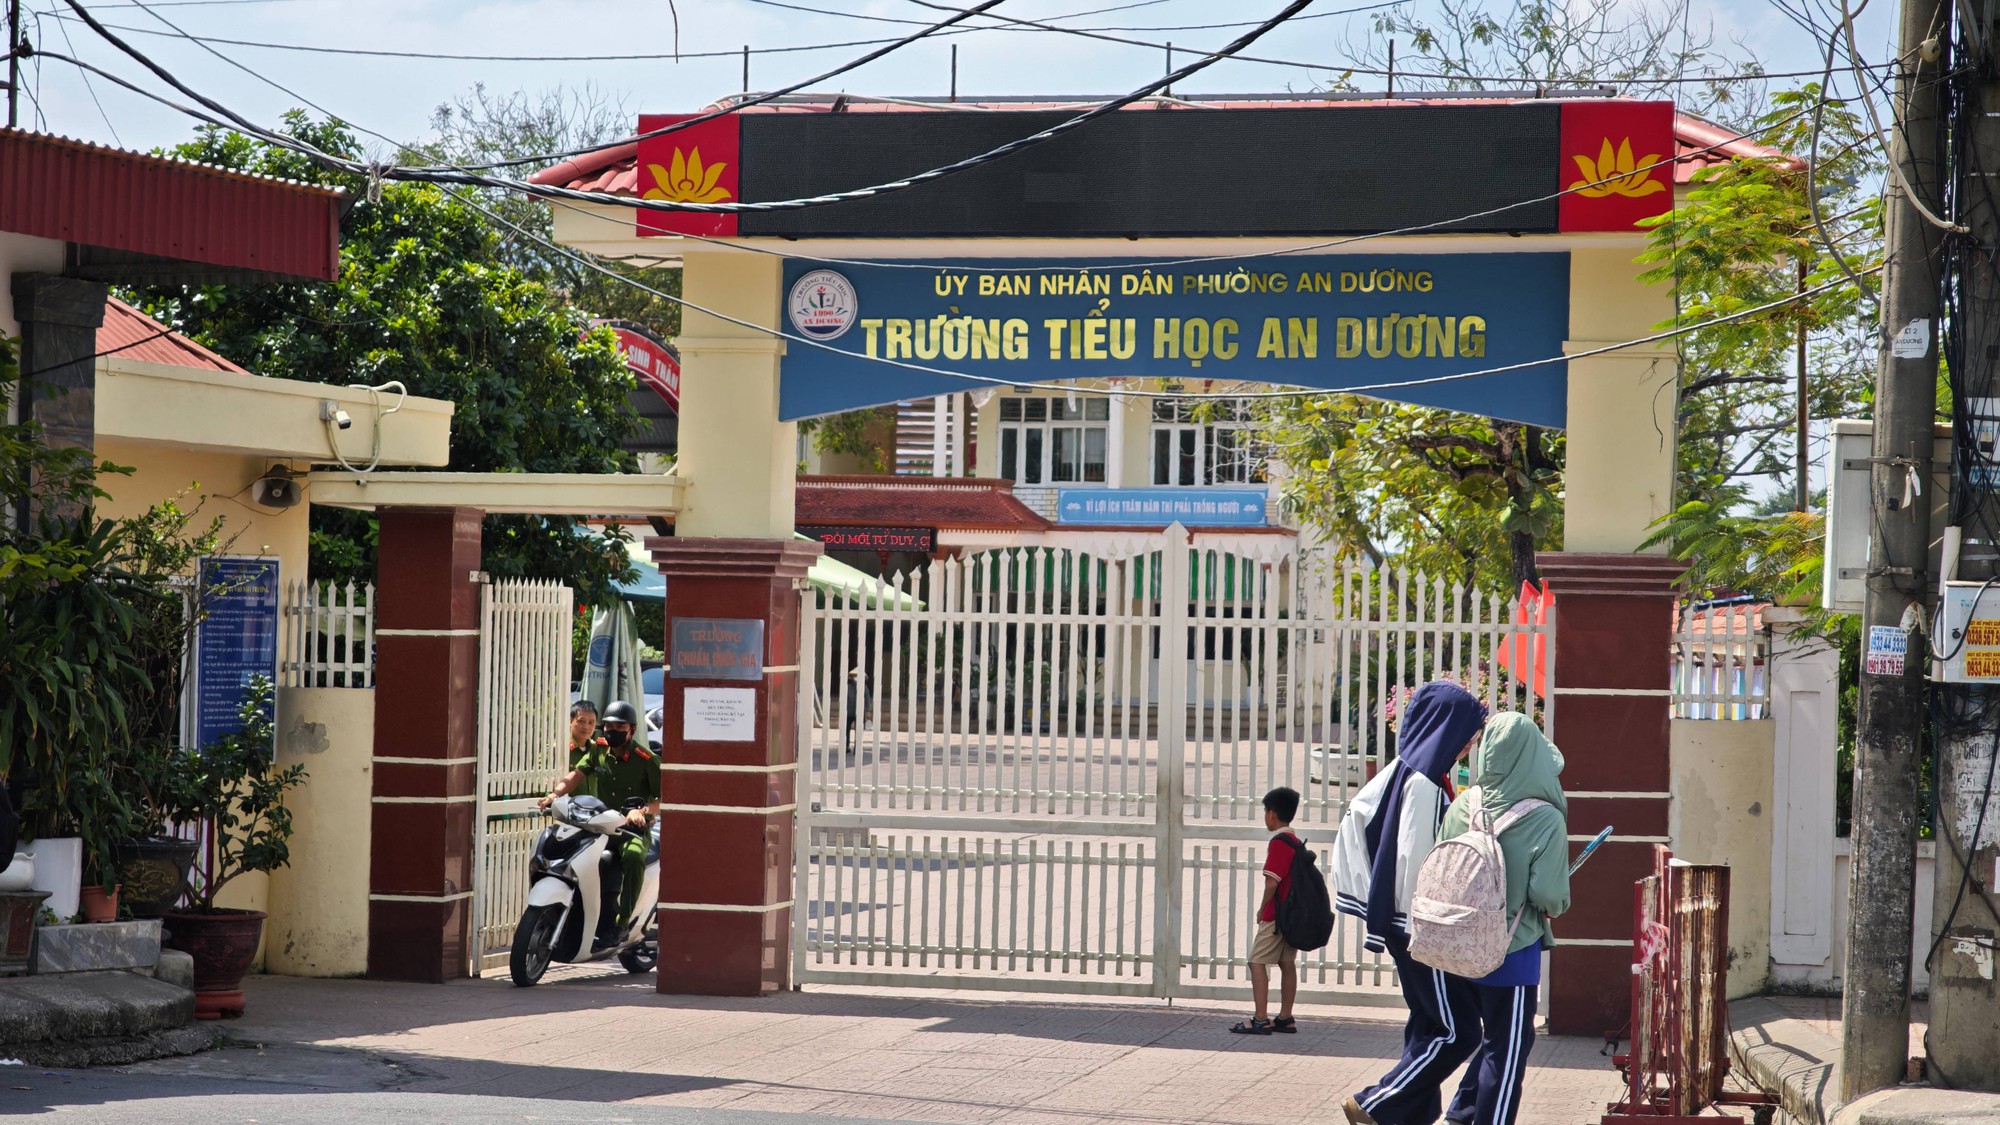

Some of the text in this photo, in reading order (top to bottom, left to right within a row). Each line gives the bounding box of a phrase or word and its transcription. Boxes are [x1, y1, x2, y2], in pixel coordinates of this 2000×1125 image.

[978, 274, 1031, 296] BAN
[1040, 269, 1111, 296] NHÂN
[1121, 269, 1173, 296] DÂN
[1183, 266, 1289, 295] PHƯỜNG
[1296, 271, 1332, 294] AN
[1340, 268, 1434, 293] DƯƠNG
[860, 297, 1487, 368] TRƯỜNG TIỂU HỌC AN DƯƠNG
